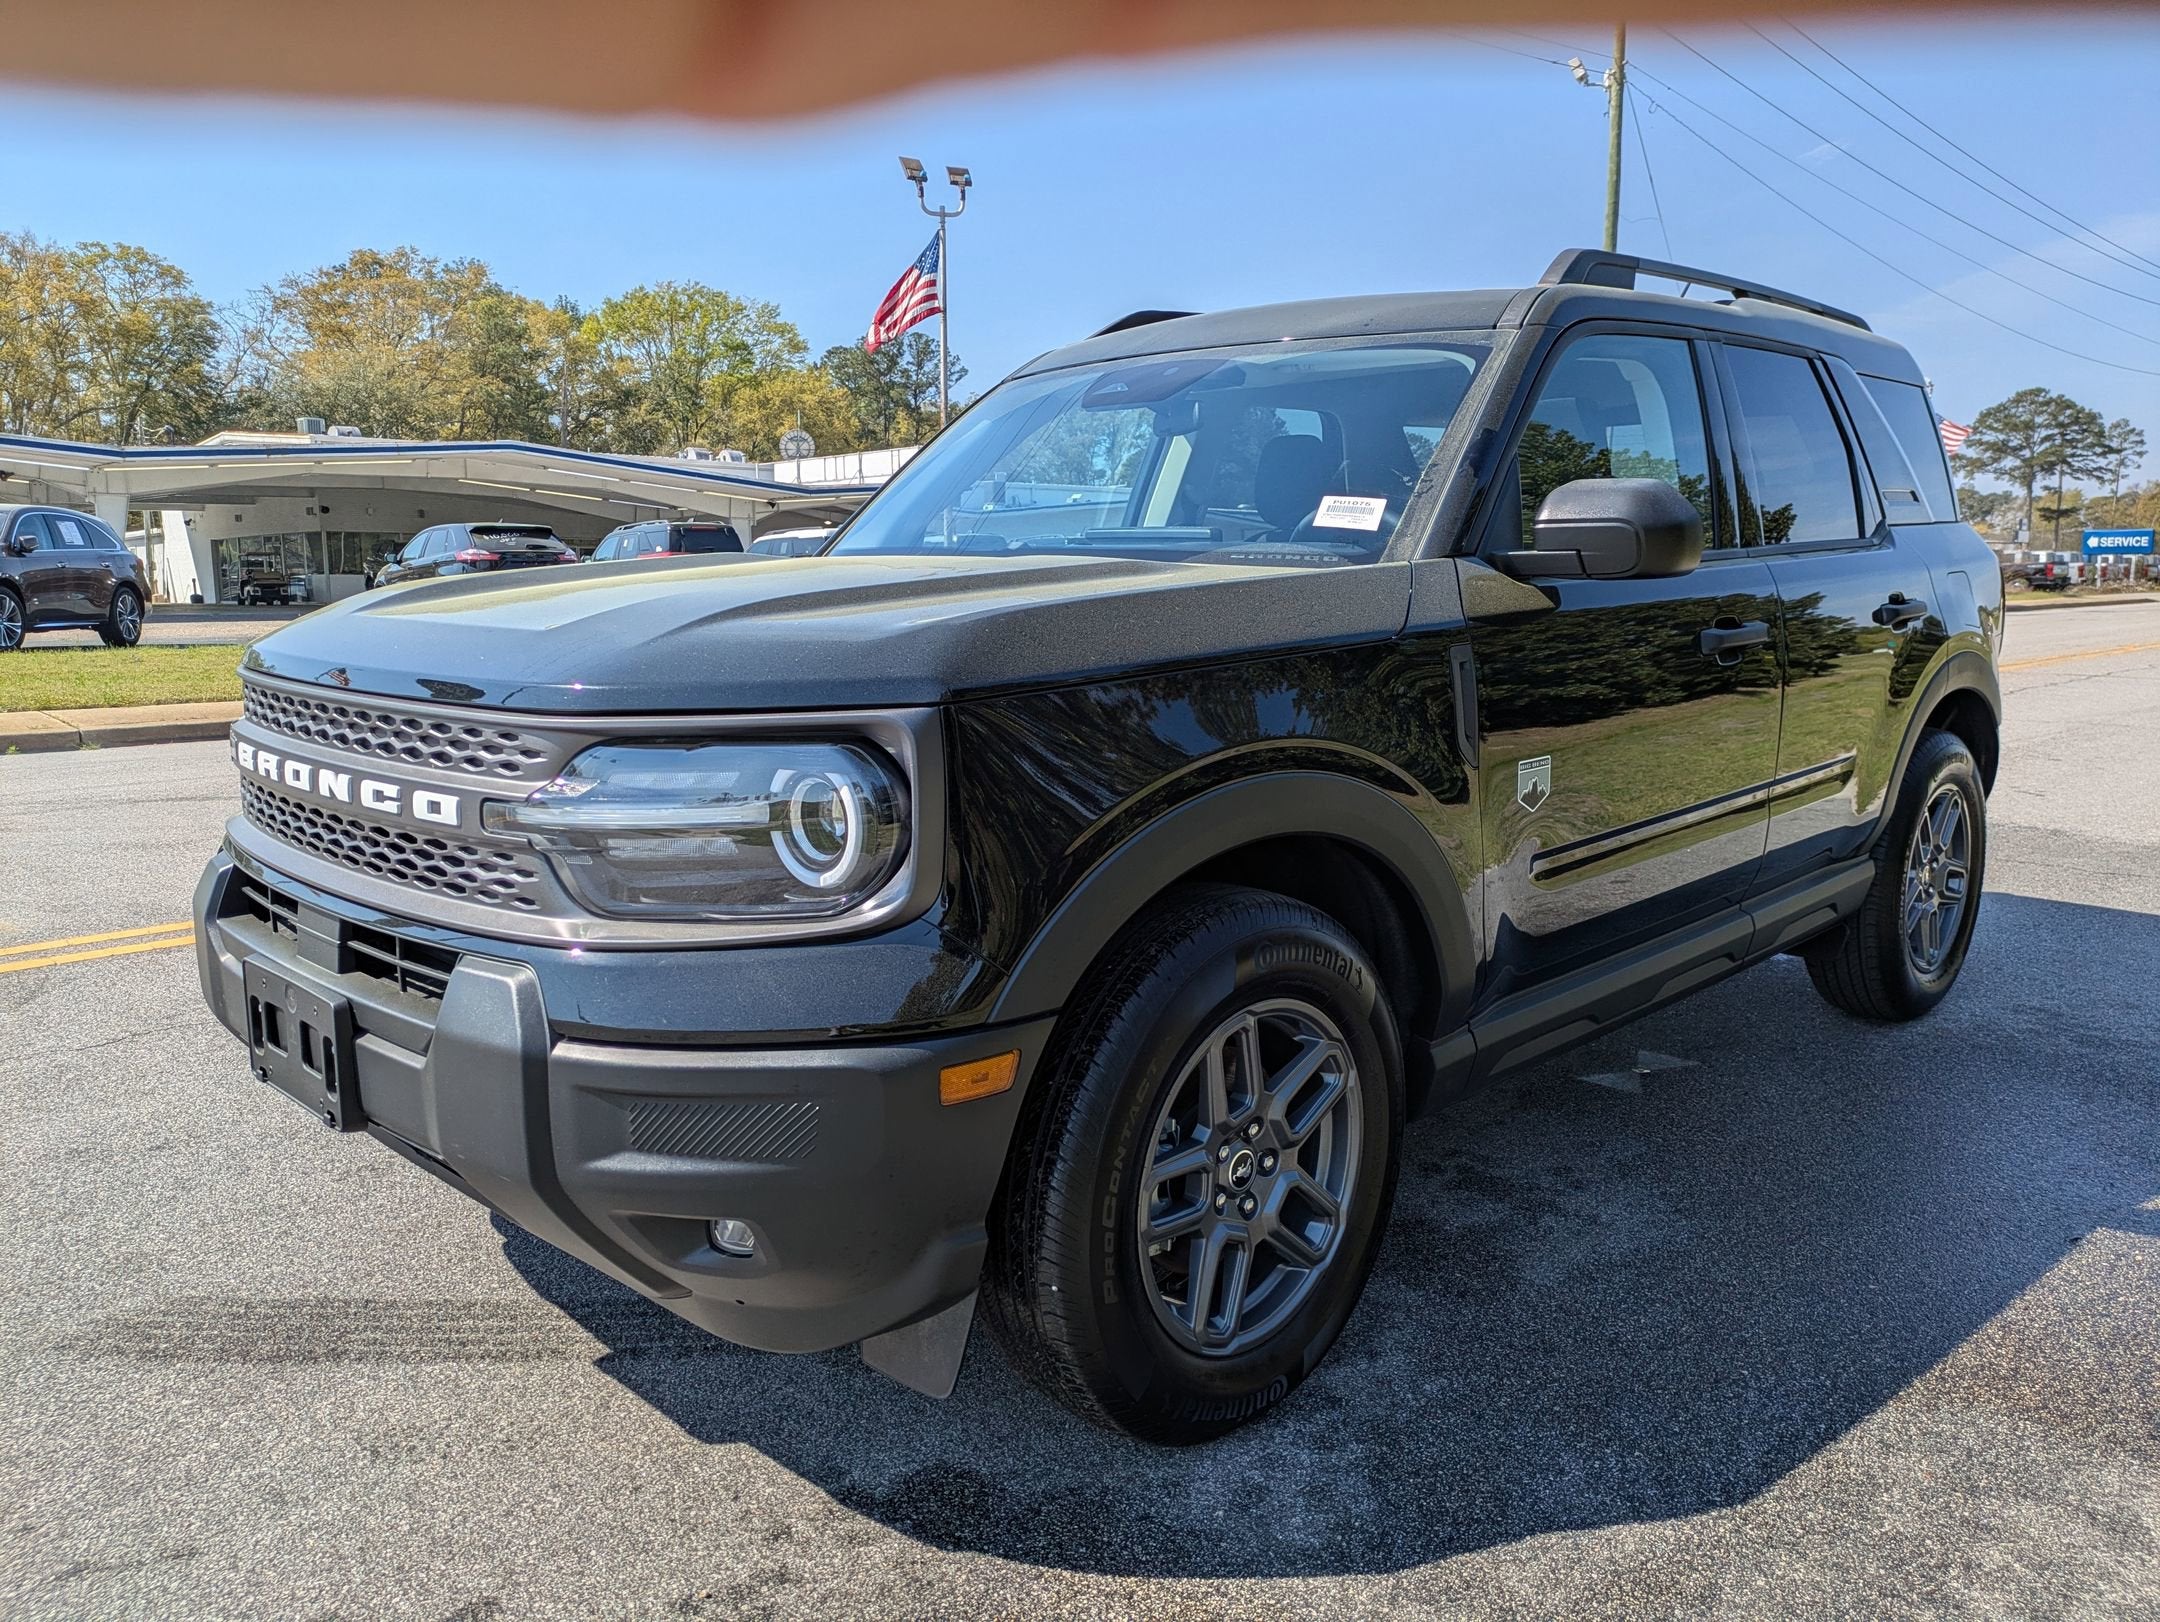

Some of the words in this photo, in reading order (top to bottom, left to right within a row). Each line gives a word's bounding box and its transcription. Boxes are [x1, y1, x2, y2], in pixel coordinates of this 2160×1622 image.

[2099, 536, 2149, 547] SERVICE
[1532, 759, 1549, 767] BEND
[237, 742, 460, 827] BRONCO
[1254, 941, 1354, 983] Continental
[1102, 1056, 1160, 1304] PROCONTACT
